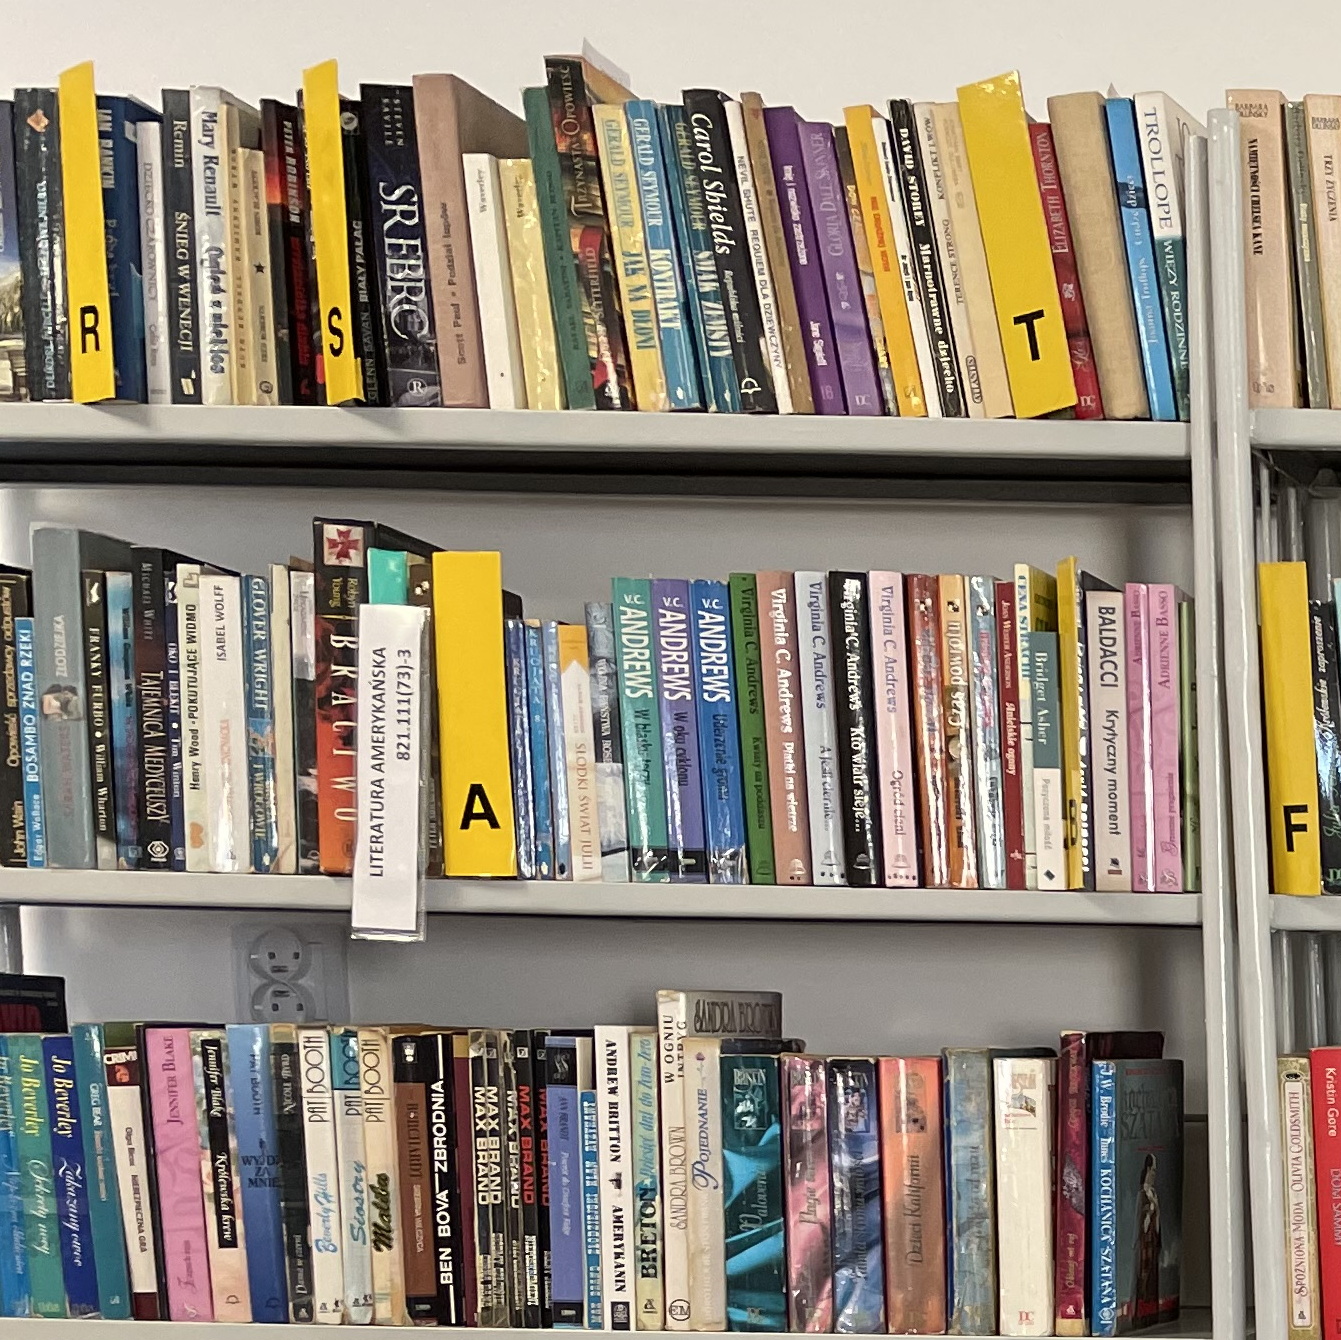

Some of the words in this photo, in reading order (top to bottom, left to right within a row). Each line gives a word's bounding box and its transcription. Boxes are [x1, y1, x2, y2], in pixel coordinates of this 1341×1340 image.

[174, 120, 186, 169] Remin
[1142, 106, 1172, 230] TROLLOPE
[175, 264, 190, 277] W
[82, 306, 100, 354] R
[176, 282, 192, 352] WENECJI
[327, 306, 346, 358] S
[1012, 310, 1044, 360] T
[619, 606, 652, 699] ANDREWS
[698, 609, 730, 702] ANDREWS
[1098, 605, 1118, 688] BALDACCI
[371, 646, 388, 774] AMERYKAŃSKA
[396, 648, 412, 760] 821.111(73)-3
[1105, 708, 1119, 780] Krytyczny
[369, 780, 386, 879] LITERATURA
[460, 784, 500, 829] A
[1108, 784, 1120, 836] moment
[1282, 805, 1309, 852] F
[605, 1039, 619, 1092] ANDREW
[431, 1080, 445, 1172] ZBRODNIA
[608, 1094, 622, 1162] BRITTON
[436, 1191, 451, 1238] BOVA
[612, 1205, 626, 1292] AMERYKANIN
[440, 1248, 454, 1285] BEN
